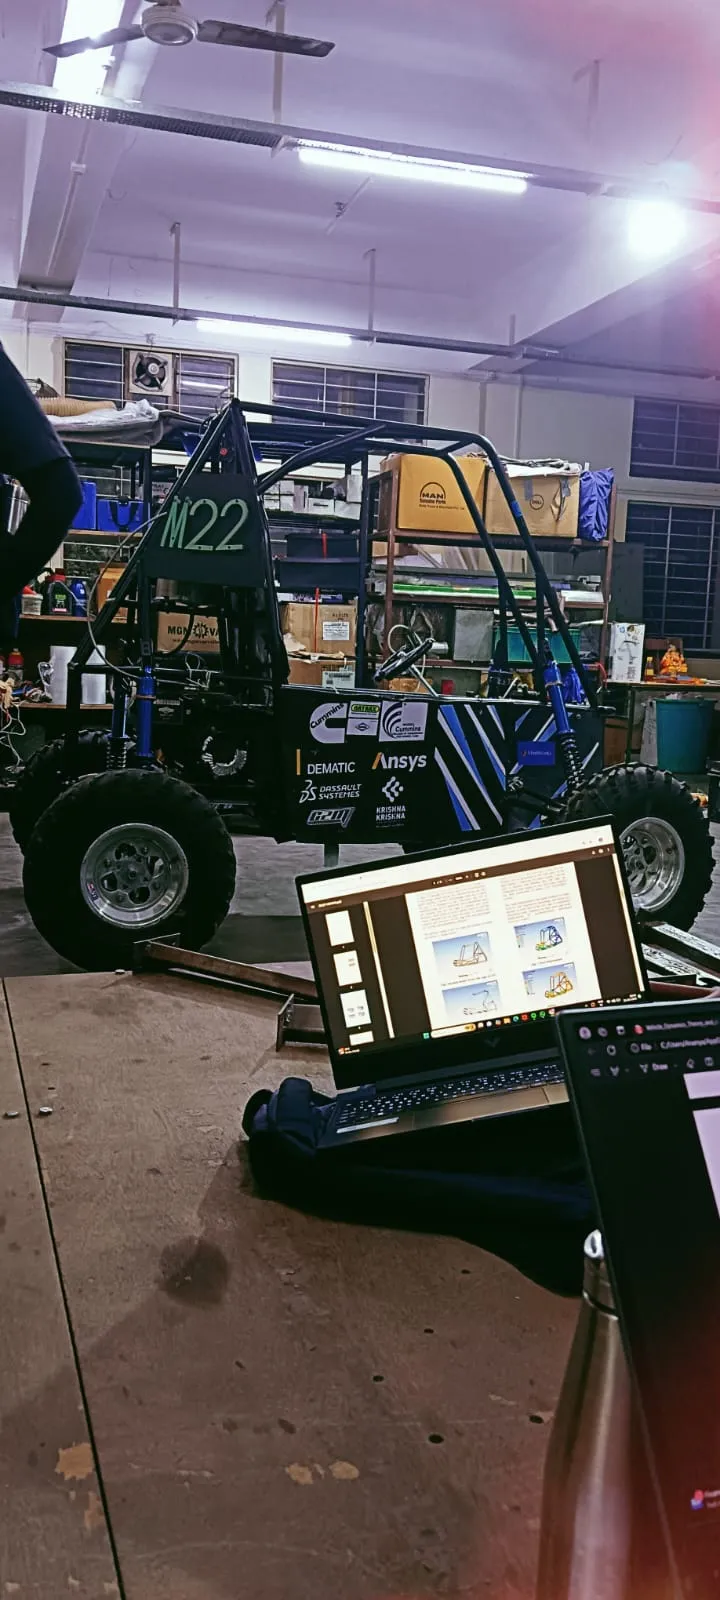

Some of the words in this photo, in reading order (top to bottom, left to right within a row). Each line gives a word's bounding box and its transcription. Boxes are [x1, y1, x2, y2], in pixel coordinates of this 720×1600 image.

[160, 496, 249, 551] M22
[311, 703, 345, 728] Cummins
[307, 762, 356, 775] DEMATIC
[372, 752, 427, 772] Ansys
[319, 784, 362, 793] DASSAULT
[376, 805, 406, 814] KRISHNA
[375, 812, 406, 821] KRISHNA
